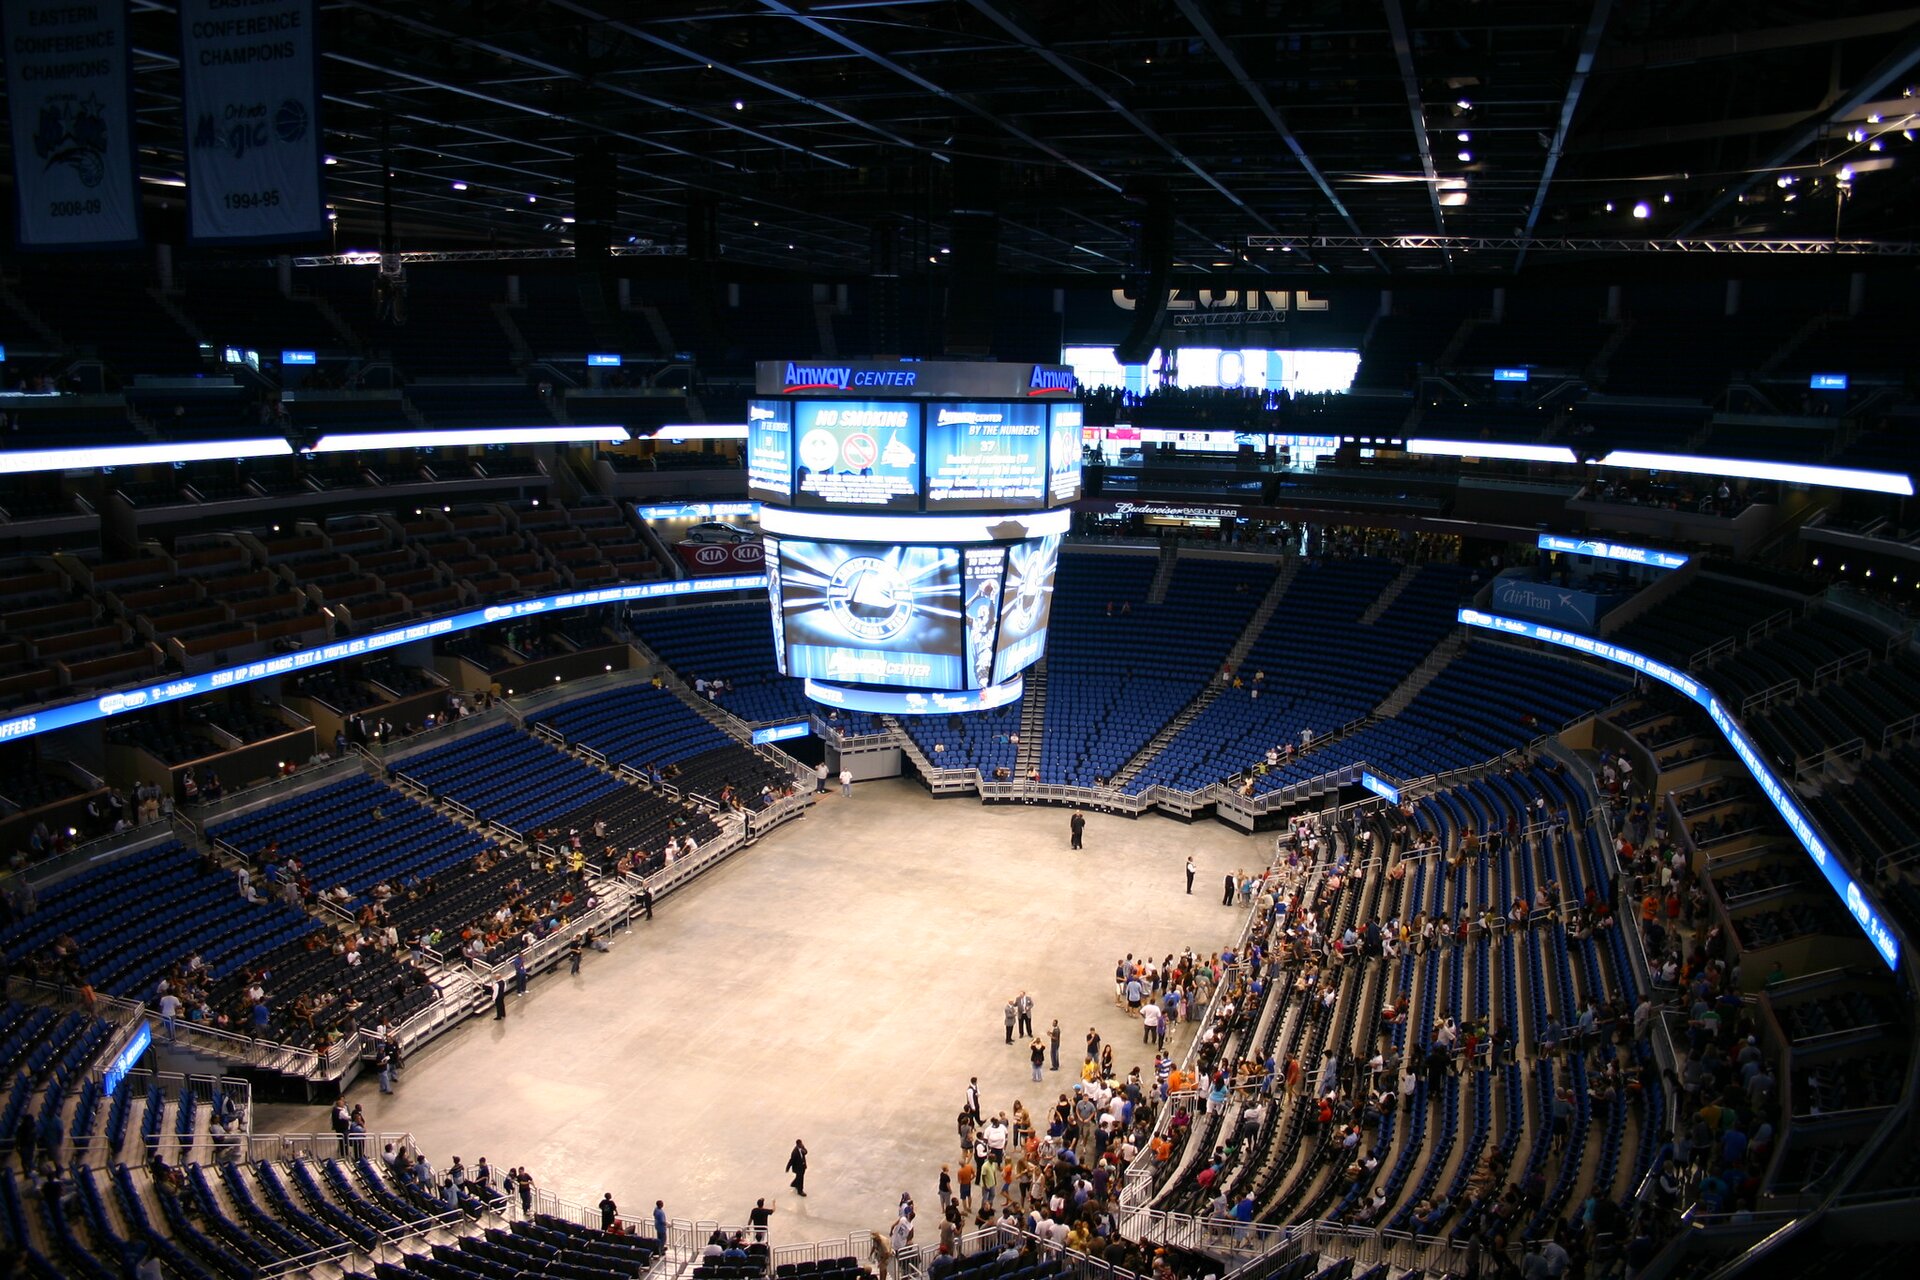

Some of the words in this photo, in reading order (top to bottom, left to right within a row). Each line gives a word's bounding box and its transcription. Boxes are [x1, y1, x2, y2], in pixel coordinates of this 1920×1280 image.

[29, 5, 98, 26] EASTERN
[192, 11, 301, 39] CONFERENCE
[14, 30, 115, 53] CONFERENCE
[200, 41, 295, 66] CHAMPIONS
[22, 59, 110, 81] CHAMPIONS
[51, 199, 101, 216] 2008-09
[224, 190, 280, 209] 1994-95
[785, 361, 851, 390] Amway
[854, 371, 917, 387] CENTER
[1030, 365, 1073, 392] Amway
[816, 410, 838, 426] NO
[840, 411, 909, 428] SMOKING
[969, 425, 986, 436] BY
[983, 425, 999, 436] THE
[999, 425, 1040, 437] NUMBERS
[1115, 502, 1183, 517] Budweiser
[702, 549, 723, 561] KIA
[738, 547, 759, 558] KIA
[212, 673, 233, 687] SIGN
[235, 670, 248, 681] UP
[249, 667, 266, 679] FOR
[295, 654, 315, 667] TEXT
